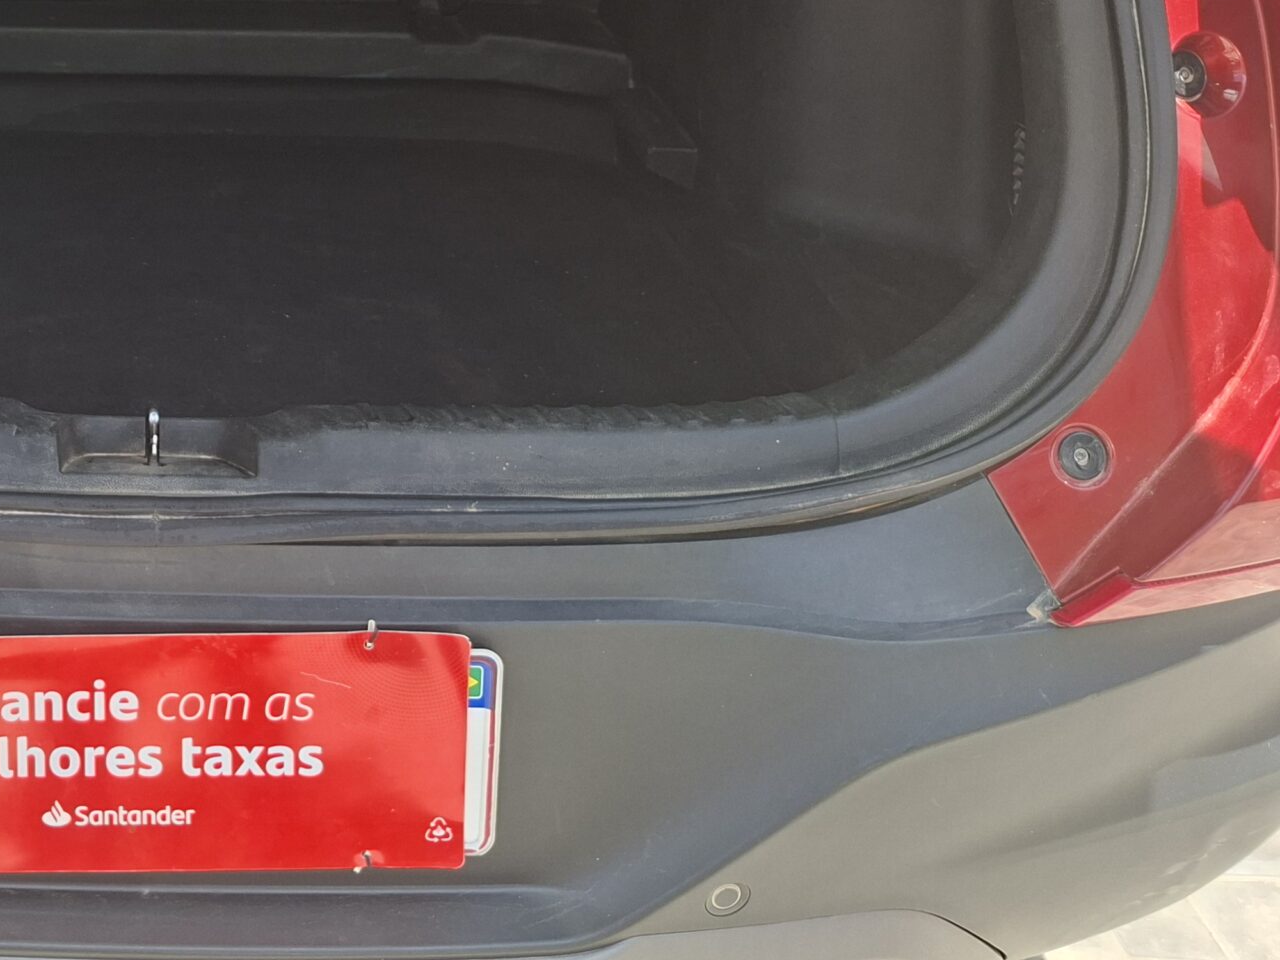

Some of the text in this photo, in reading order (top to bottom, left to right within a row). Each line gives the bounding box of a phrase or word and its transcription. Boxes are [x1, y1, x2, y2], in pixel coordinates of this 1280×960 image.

[157, 692, 251, 721] com
[265, 692, 315, 721] as
[181, 737, 324, 777] taxas
[74, 805, 195, 827] Santander
